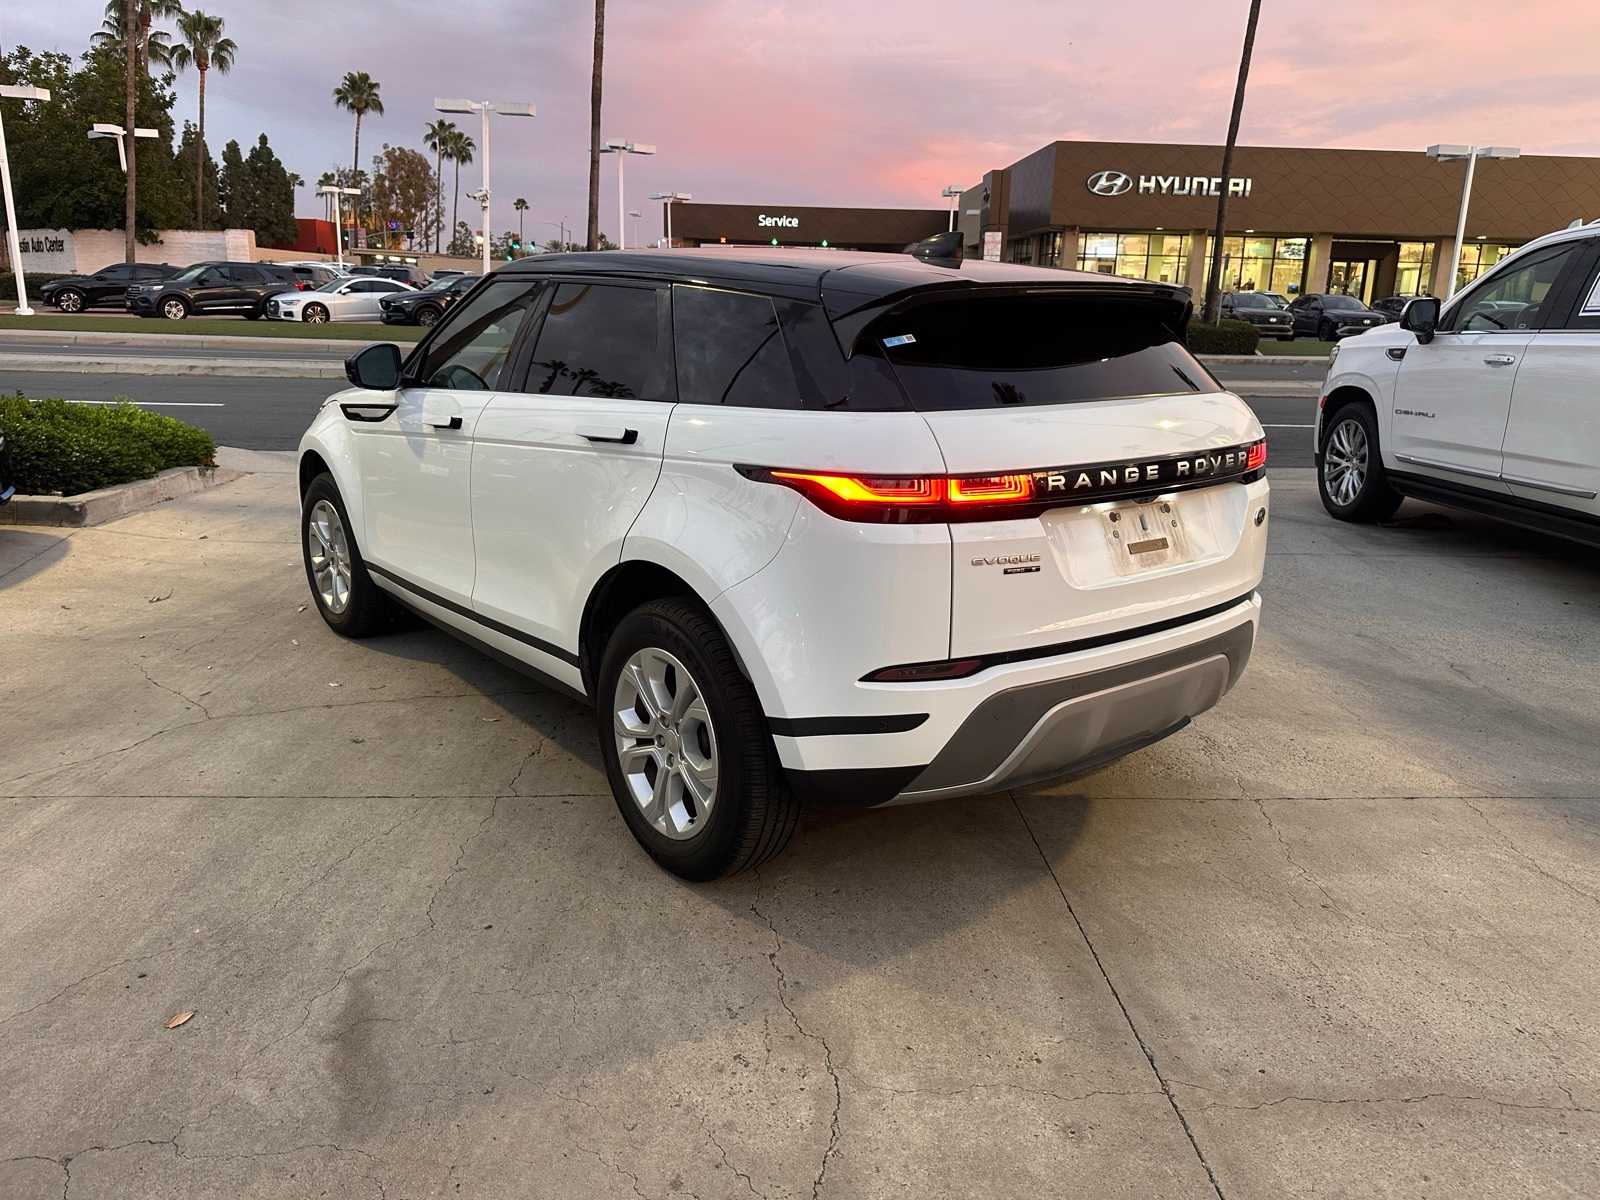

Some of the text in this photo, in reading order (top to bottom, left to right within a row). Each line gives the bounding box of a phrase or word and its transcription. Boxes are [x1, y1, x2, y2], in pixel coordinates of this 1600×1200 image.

[1138, 175, 1252, 197] HYUNDAI
[758, 214, 799, 228] Service
[31, 237, 44, 253] Auto
[45, 236, 64, 253] Center
[1046, 451, 1248, 492] RANGE ROVER
[971, 553, 1041, 566] EVOQUE
